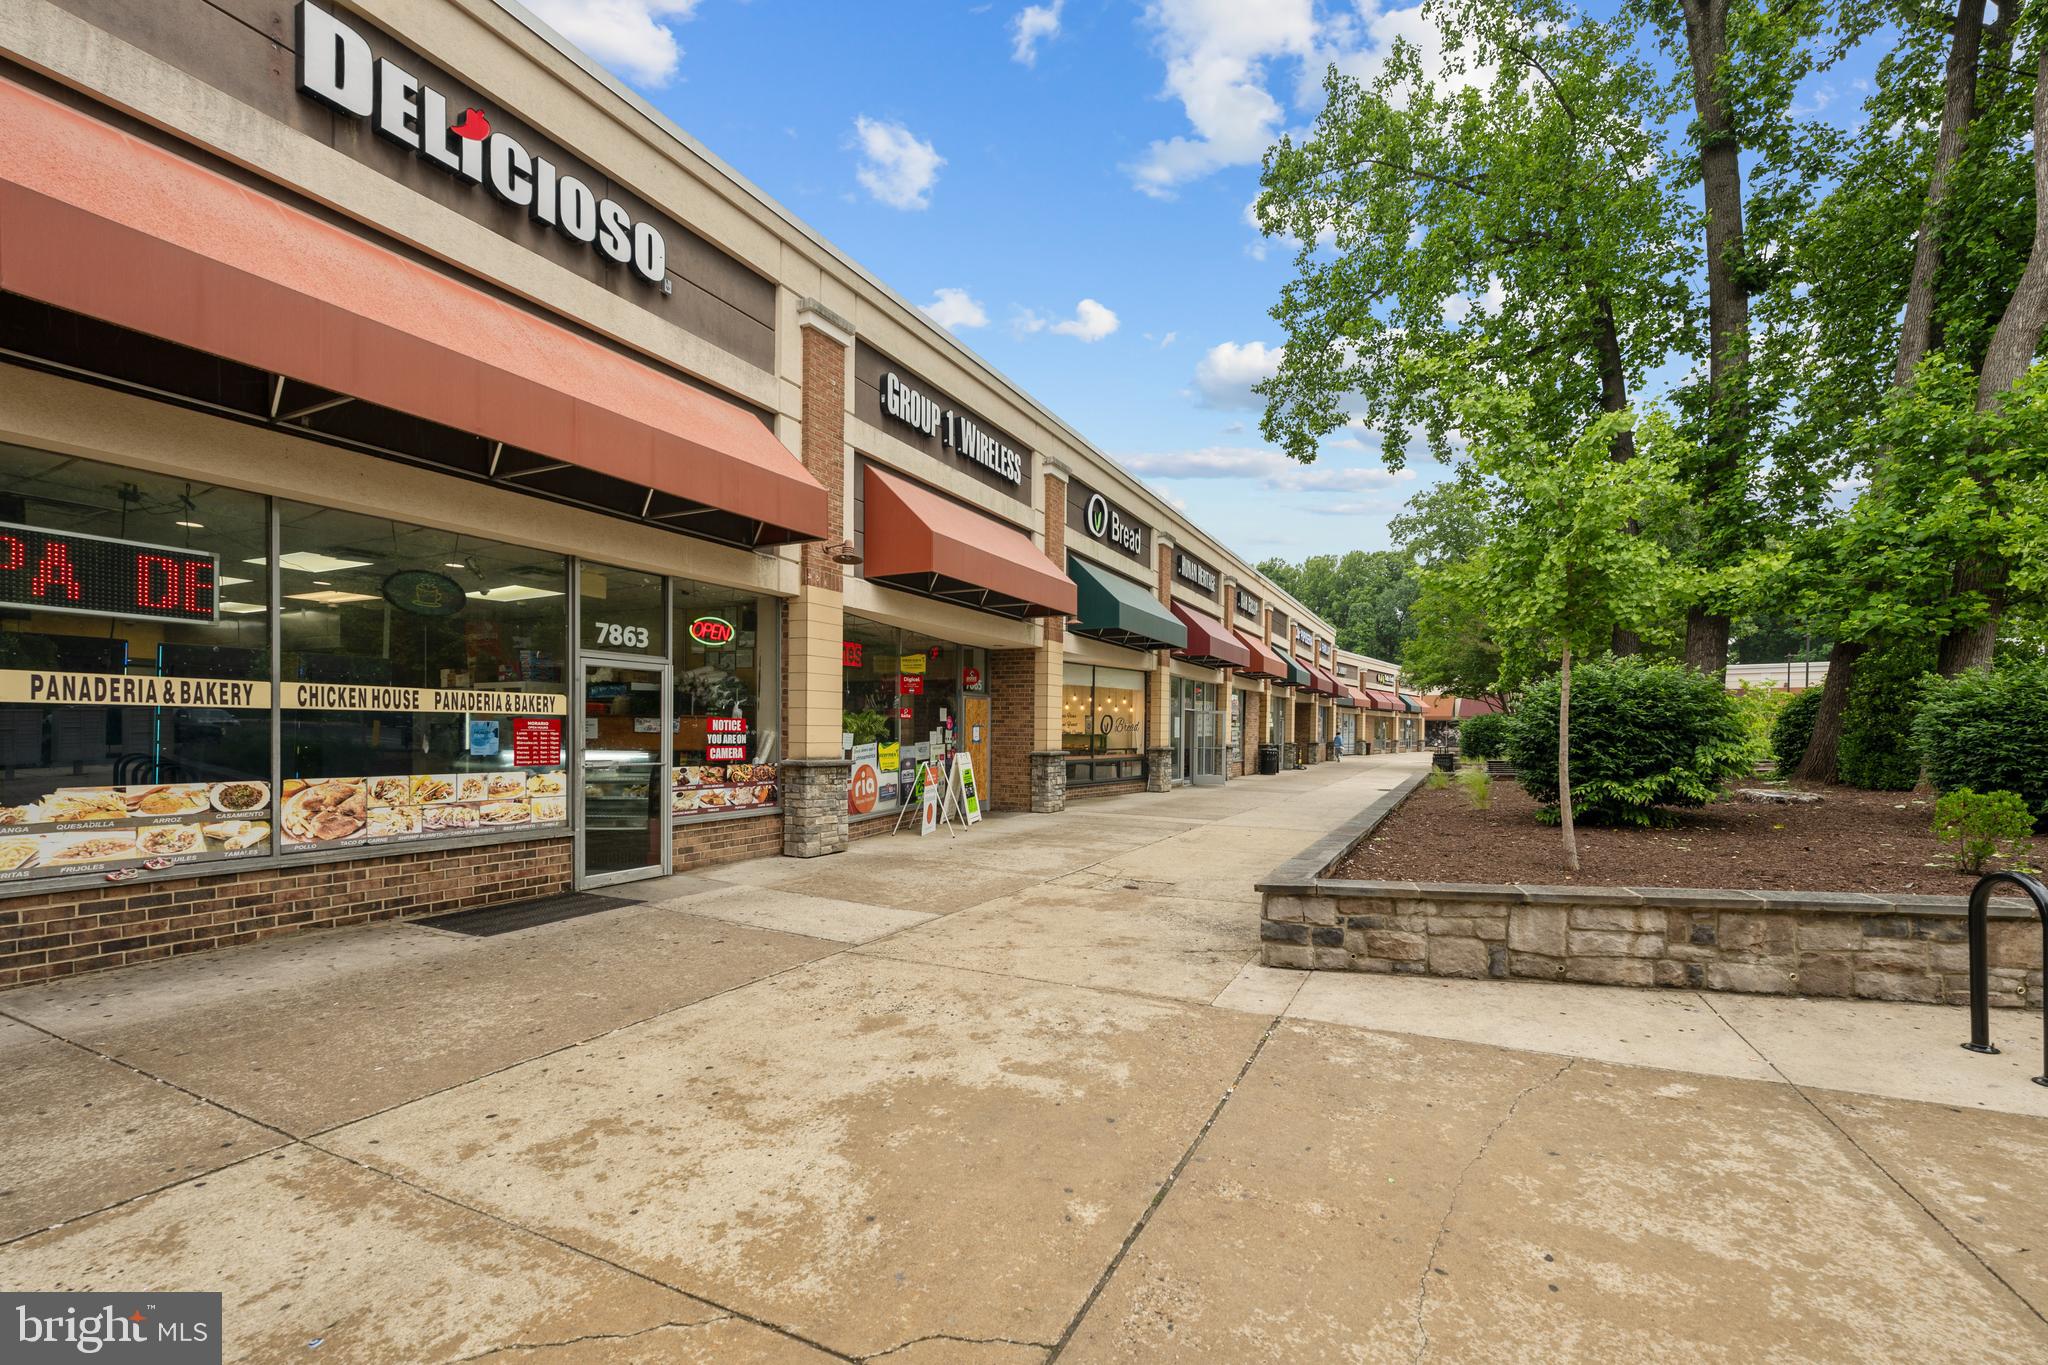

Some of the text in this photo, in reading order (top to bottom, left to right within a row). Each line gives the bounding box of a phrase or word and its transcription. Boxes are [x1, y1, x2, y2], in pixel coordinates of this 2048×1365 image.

[300, 0, 666, 283] DELICIOSO
[885, 372, 1022, 486] GROUP 1 WIRELESS
[1111, 512, 1142, 555] Bread
[138, 554, 214, 613] DE
[595, 622, 649, 648] 7863
[691, 622, 731, 641] OPEN
[30, 674, 254, 706] PANADERIA & BAKERY
[297, 685, 556, 714] CHICKEN HOUSE PANADERIA & BAKERY
[712, 719, 742, 731] NOTICE
[1115, 717, 1140, 734] Bread
[707, 734, 747, 744] YOU ARE ON
[709, 748, 743, 759] CAMERA
[855, 770, 875, 798] ria
[56, 821, 115, 831] QUESADILLA
[215, 811, 265, 819] CASAMIENTO
[60, 863, 105, 873] FRIJOLES
